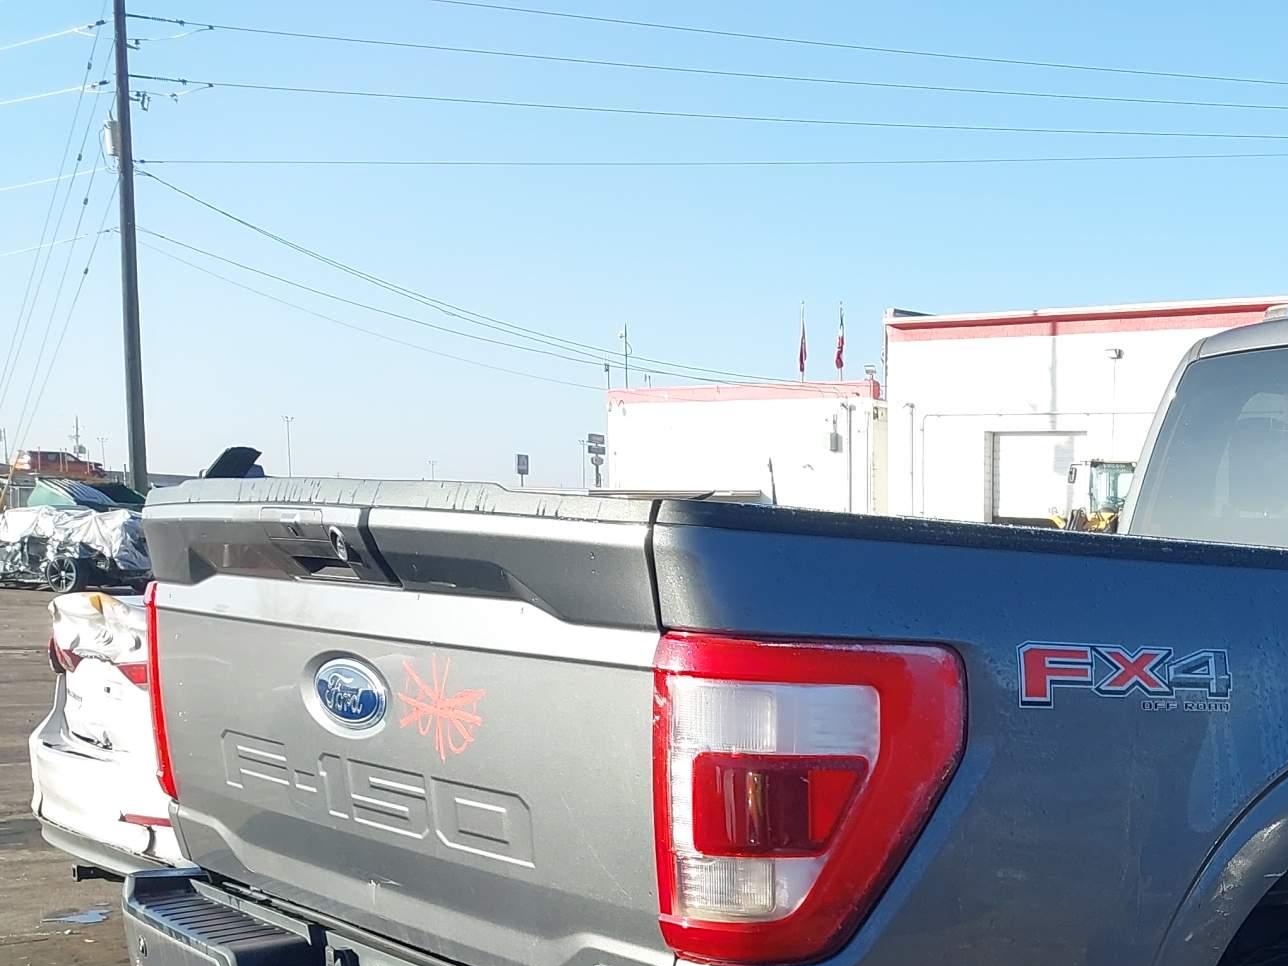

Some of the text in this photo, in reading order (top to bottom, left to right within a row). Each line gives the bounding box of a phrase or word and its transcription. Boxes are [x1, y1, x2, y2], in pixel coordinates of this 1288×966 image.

[325, 671, 364, 715] Ford
[1016, 640, 1232, 709] FX4
[1140, 700, 1231, 713] OFF ROAD
[220, 728, 536, 869] F-150
